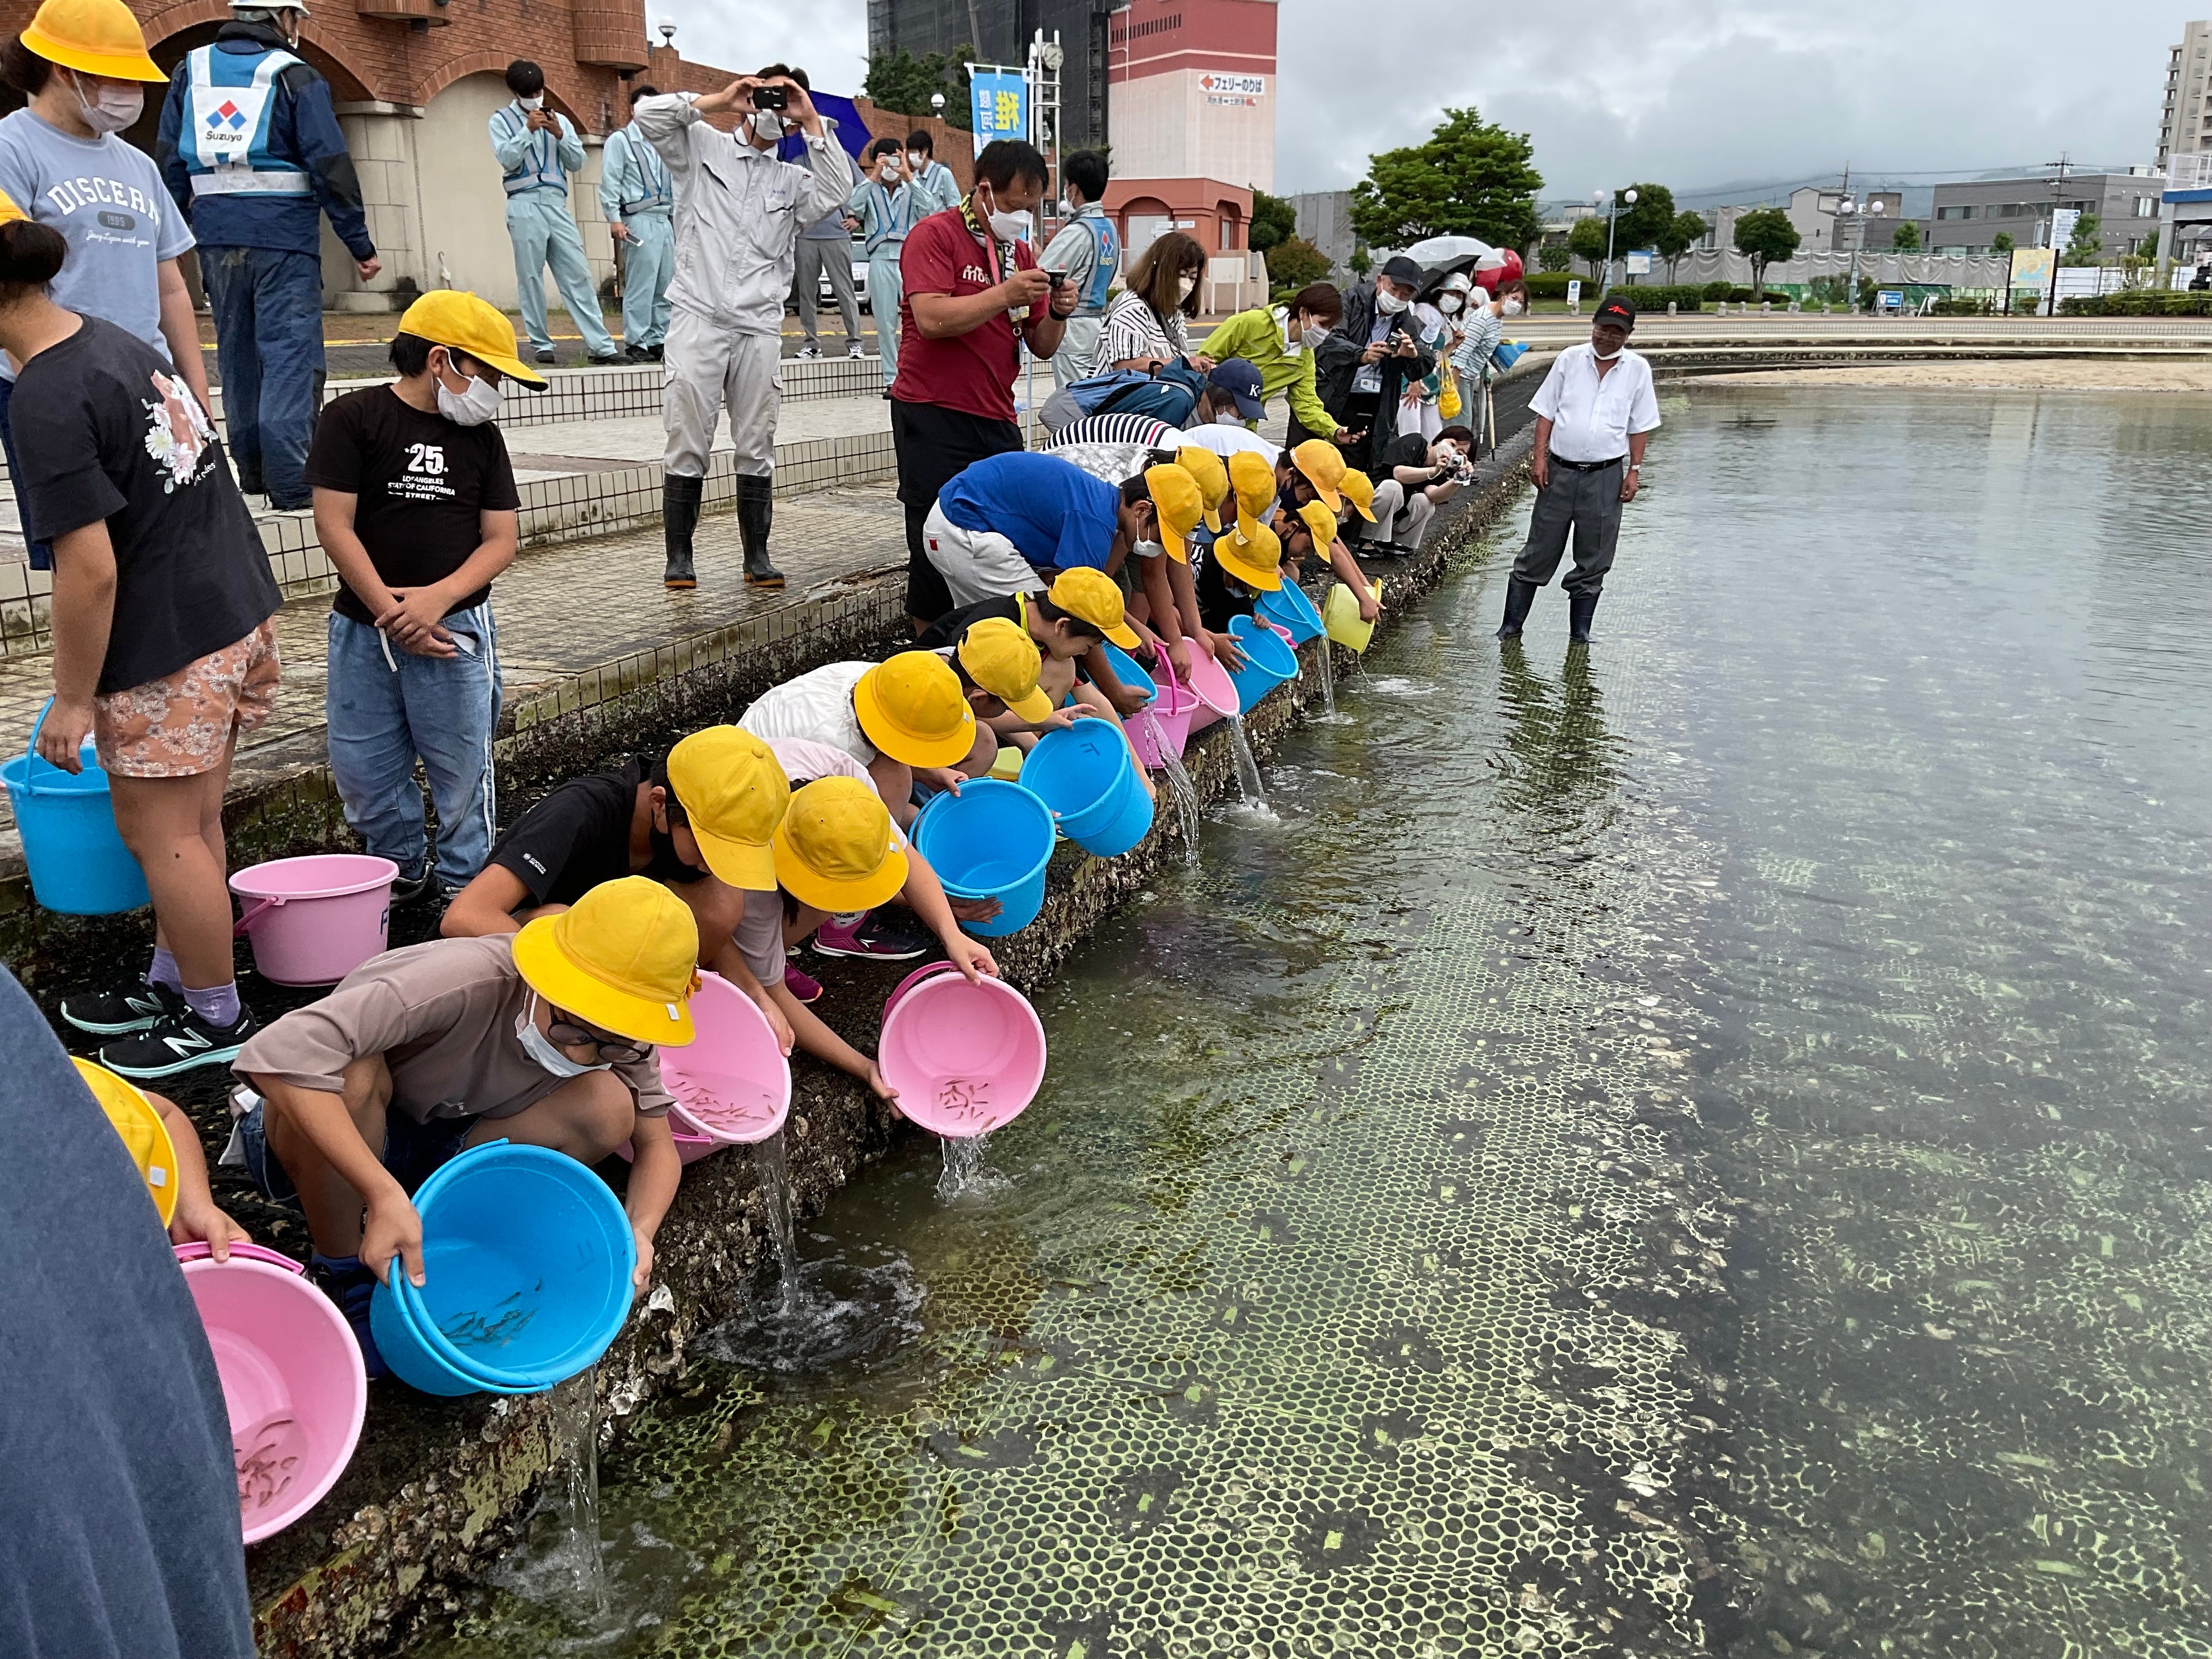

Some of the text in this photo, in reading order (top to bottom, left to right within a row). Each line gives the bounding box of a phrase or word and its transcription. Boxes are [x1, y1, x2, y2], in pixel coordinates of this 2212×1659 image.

[1214, 77, 1263, 92] フェリーのりば
[205, 130, 242, 142] Suzuyo
[408, 443, 444, 475] 25
[414, 476, 444, 486] ANGELES
[405, 492, 436, 500] STREET
[416, 484, 455, 496] CALIFORNIA
